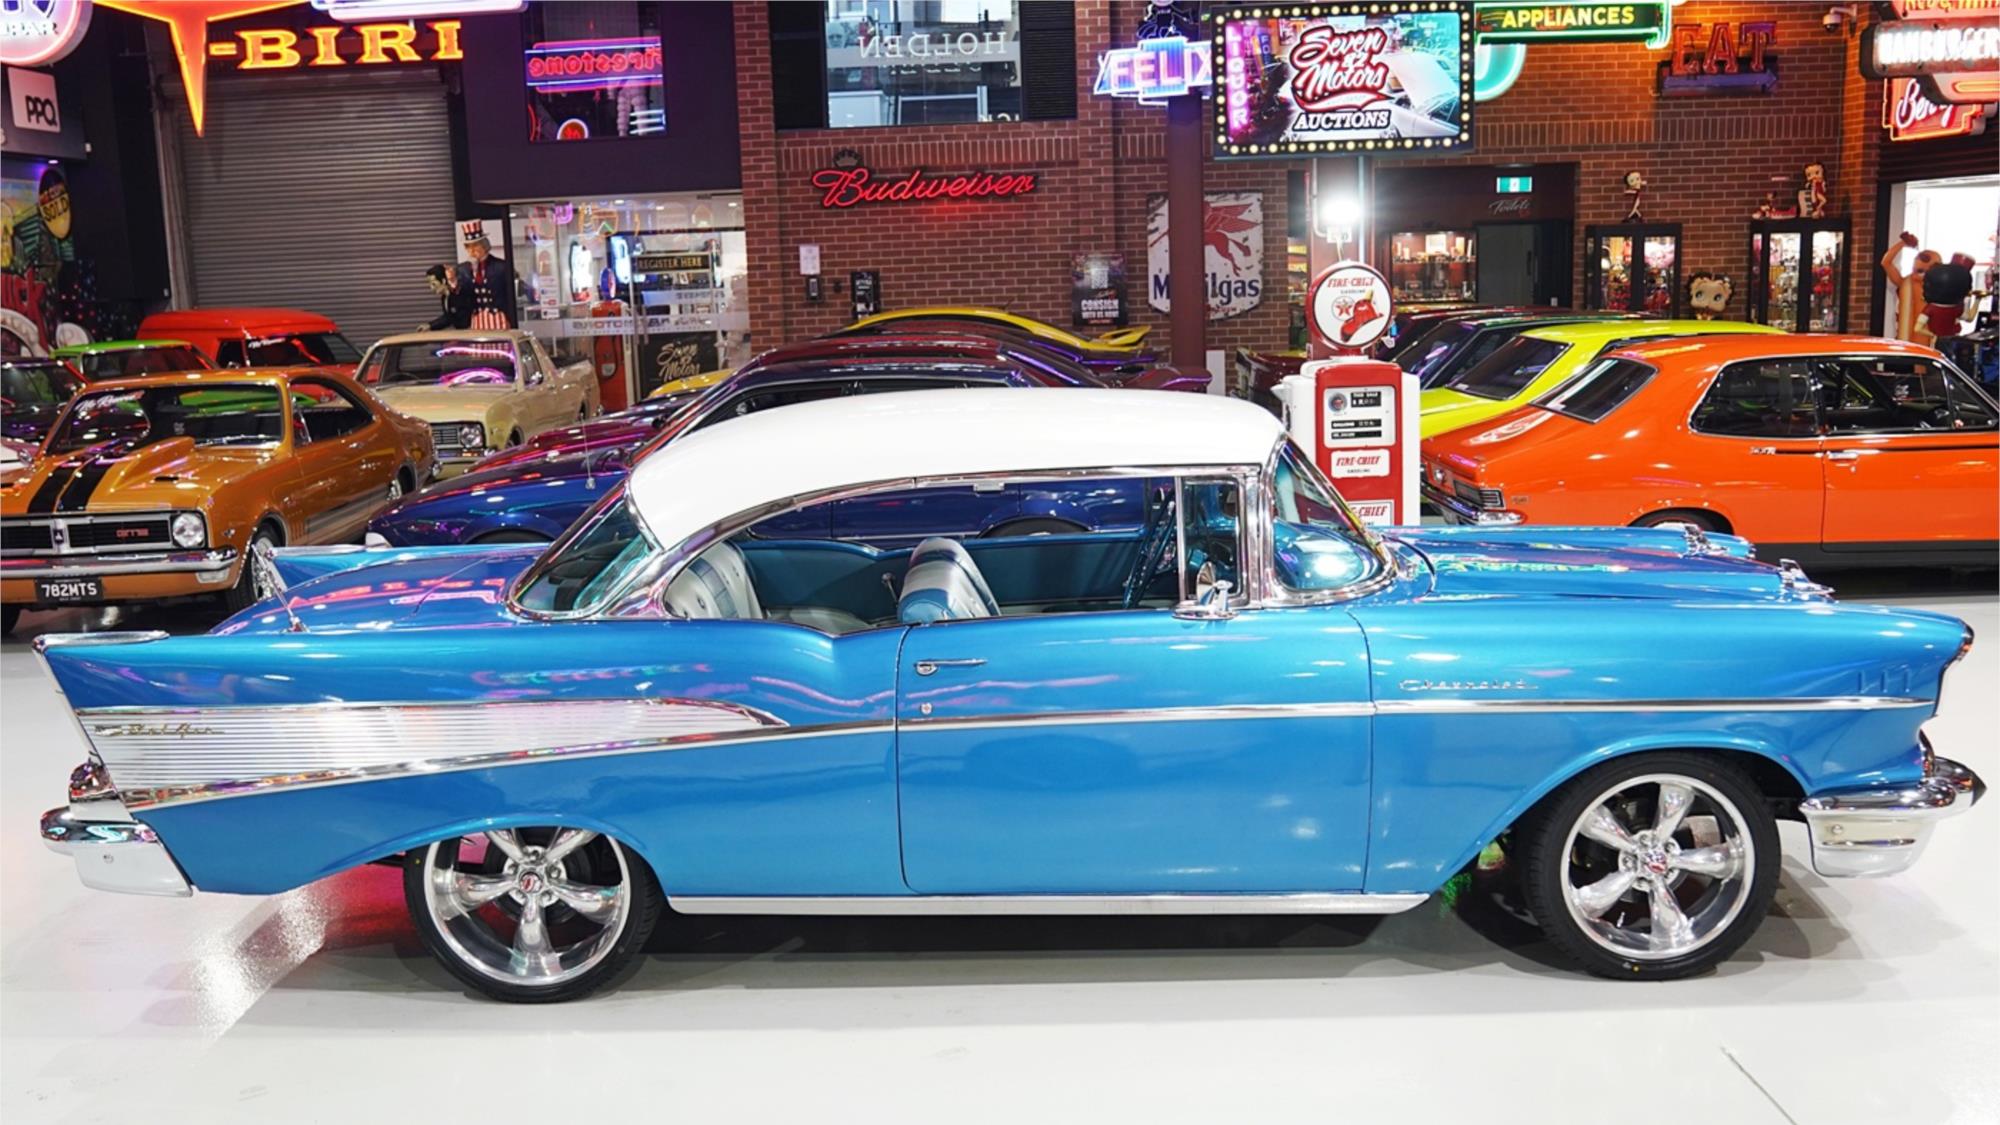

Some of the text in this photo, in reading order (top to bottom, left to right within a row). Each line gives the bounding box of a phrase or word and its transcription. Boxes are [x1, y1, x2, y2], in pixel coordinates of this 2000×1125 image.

[1502, 7, 1635, 28] APPLIANCES
[1294, 27, 1383, 66] Seven
[1672, 22, 1777, 75] EAT
[1111, 49, 1212, 89] FELIX
[1225, 25, 1248, 131] LIQUOR
[1294, 62, 1385, 100] Motors
[25, 95, 58, 127] PPQ
[1294, 110, 1390, 130] AUCTIONS
[812, 168, 1035, 208] Budweiser
[1153, 272, 1260, 306] Milgas
[1336, 456, 1381, 466] FIRE-CHIEF
[41, 582, 98, 598] 782MTS
